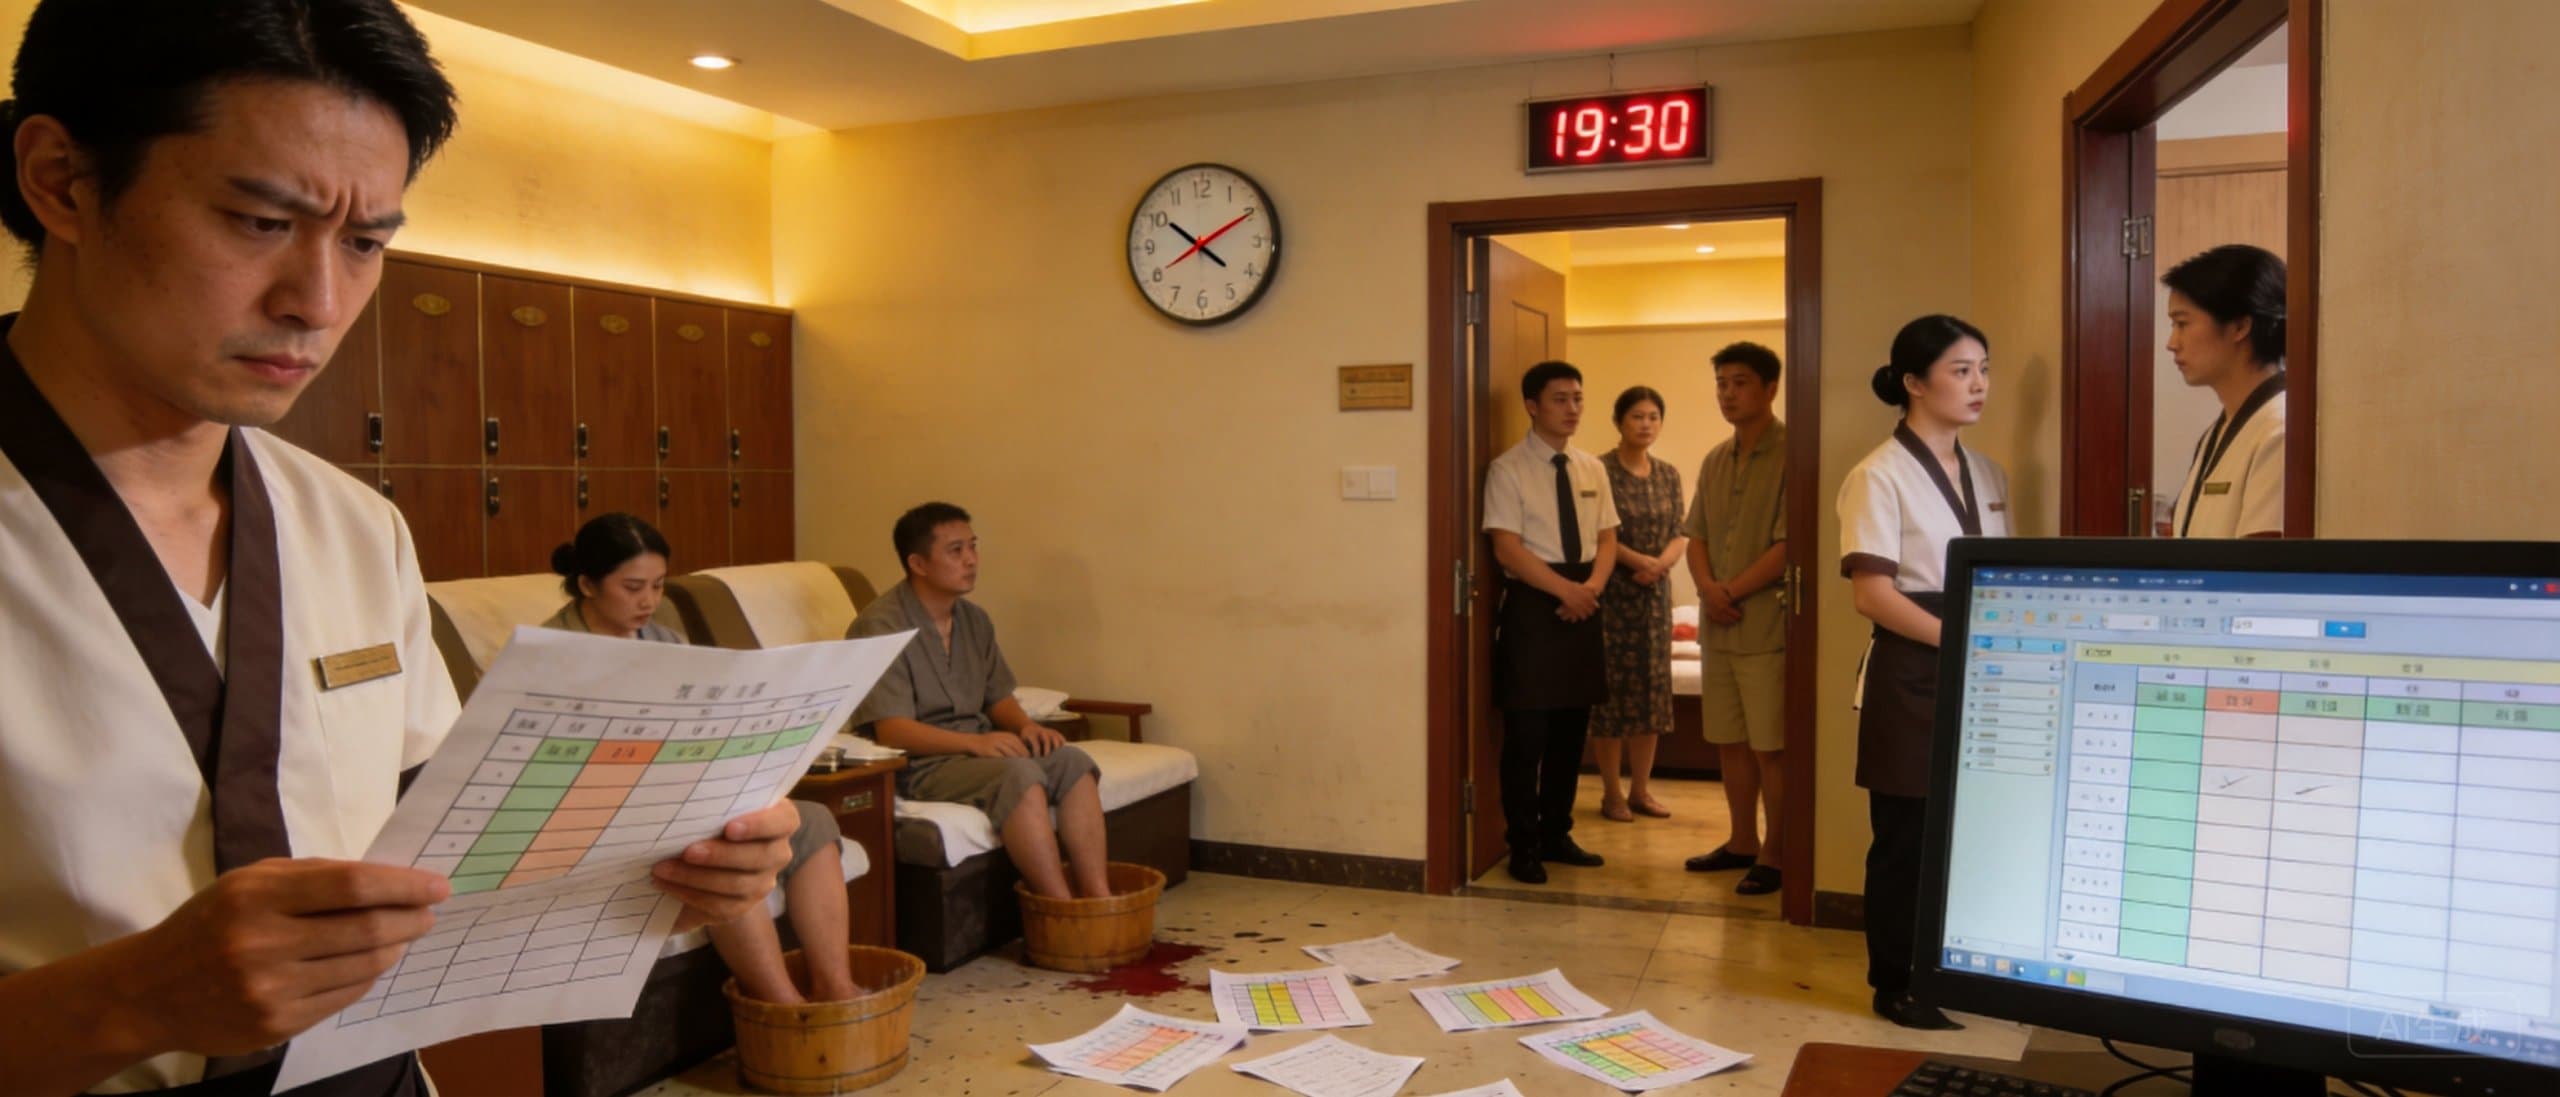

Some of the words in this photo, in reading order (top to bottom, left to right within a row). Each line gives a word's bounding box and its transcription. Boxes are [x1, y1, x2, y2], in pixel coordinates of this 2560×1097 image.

[1555, 100, 1689, 158] 19:30
[1170, 188, 1181, 206] 11
[1193, 179, 1212, 199] 12
[1227, 185, 1232, 204] 1
[1150, 211, 1168, 230] 10
[1244, 207, 1255, 221] 2
[1145, 239, 1155, 255] 9
[1252, 234, 1262, 249] 3
[1244, 262, 1255, 279] 4
[1170, 285, 1181, 302] 7
[1196, 289, 1208, 309] 6
[1225, 283, 1236, 300] 5
